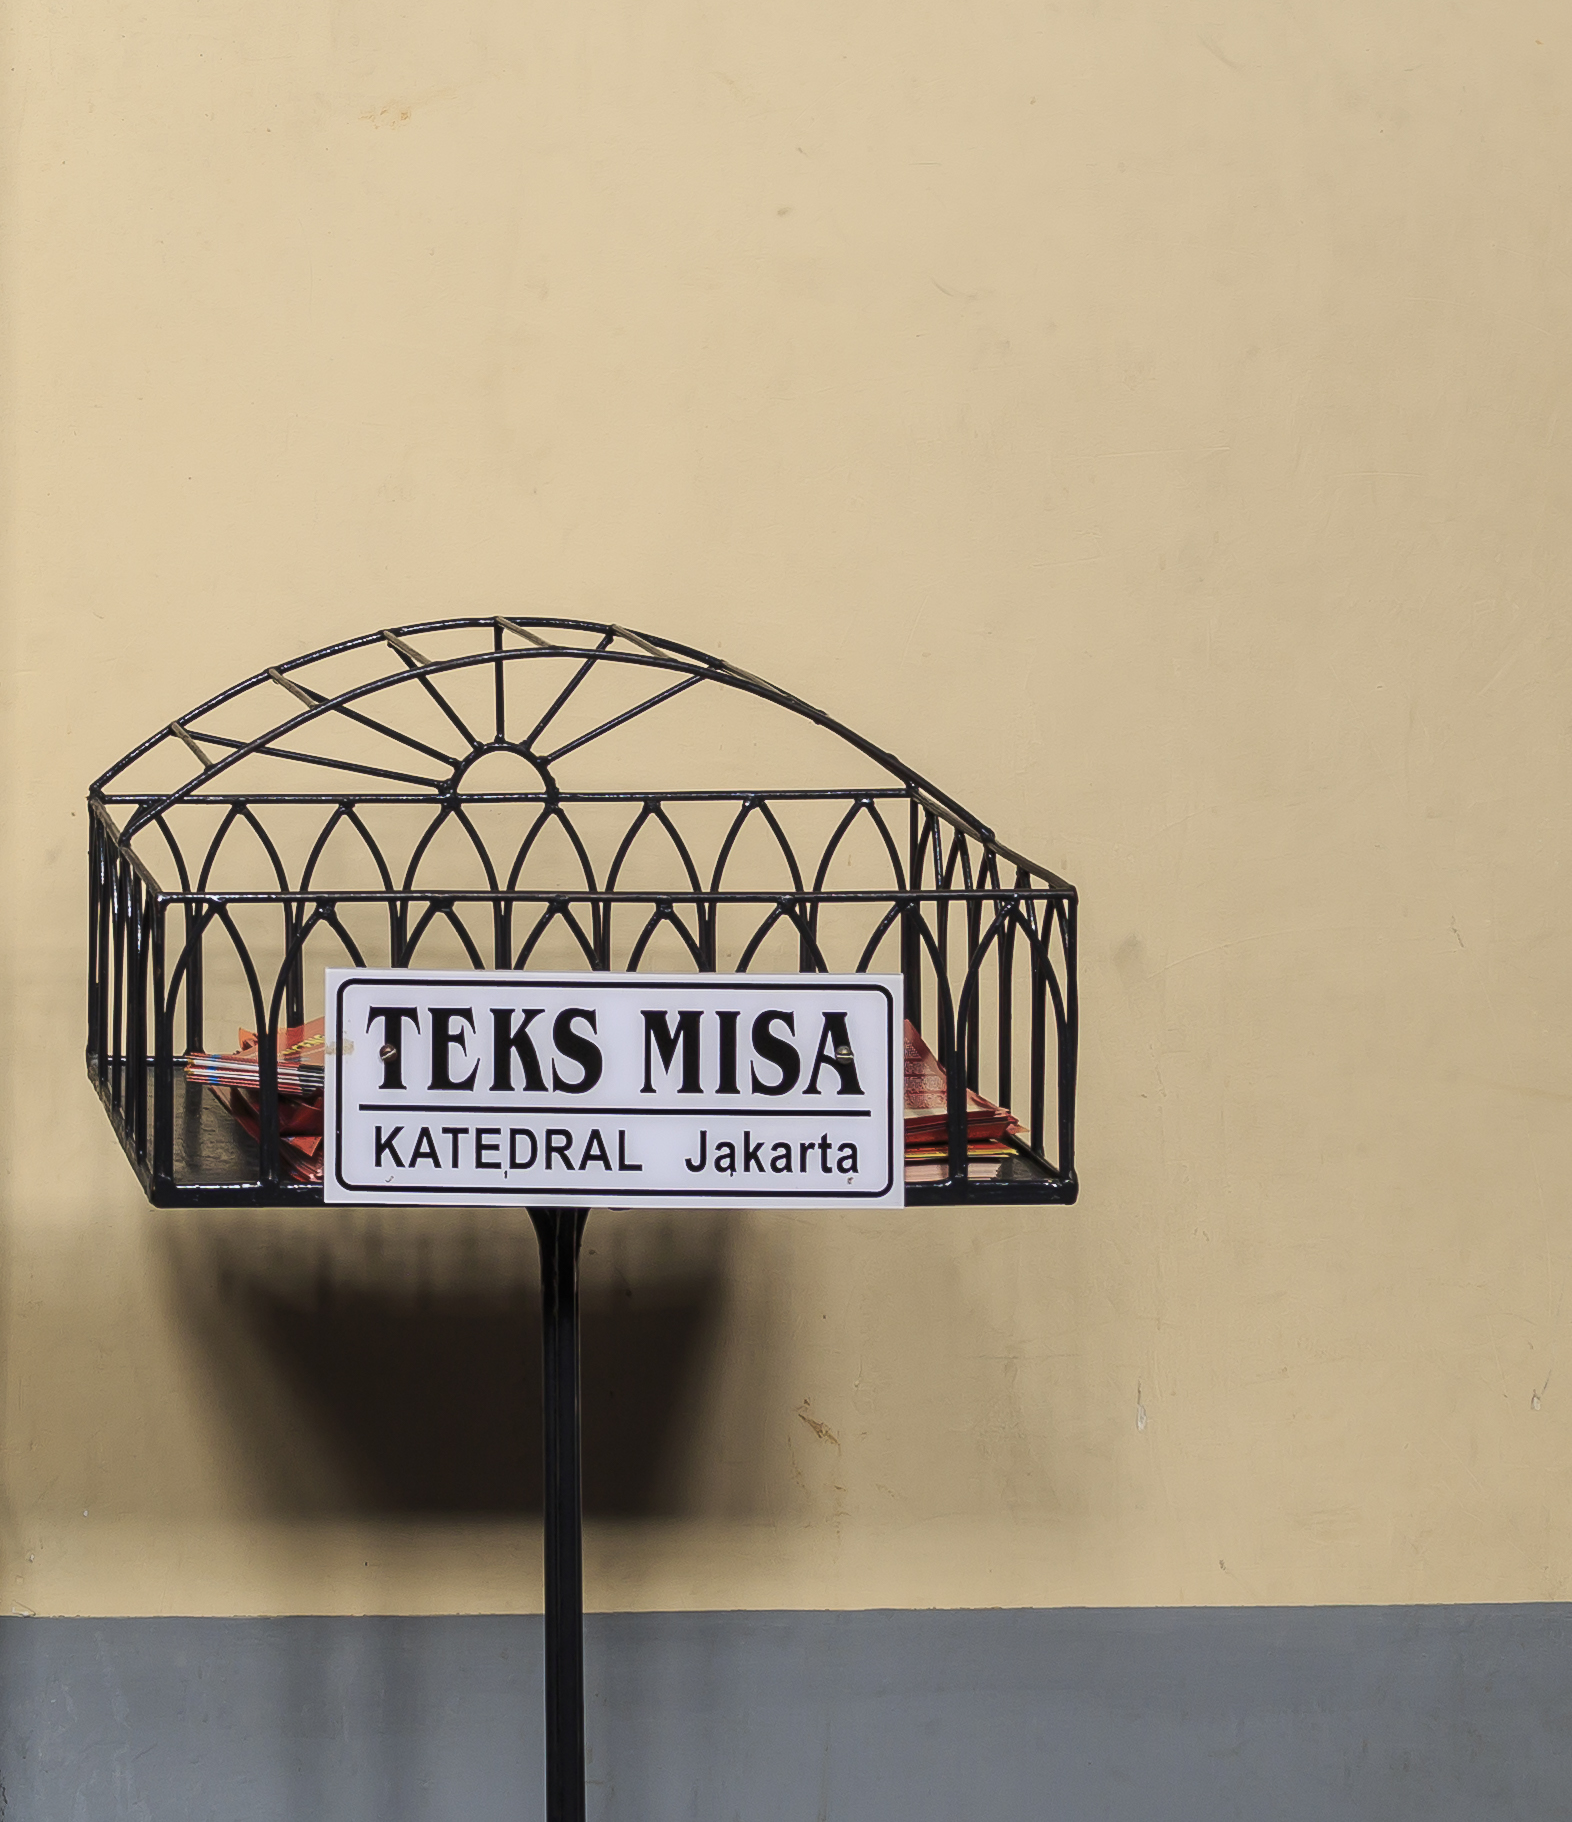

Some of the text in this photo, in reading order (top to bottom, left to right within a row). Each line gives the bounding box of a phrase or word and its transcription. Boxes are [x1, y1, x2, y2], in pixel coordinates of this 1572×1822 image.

[365, 1005, 866, 1097] TEKS MISA
[374, 1125, 860, 1176] KATEDRAL Jakarta
